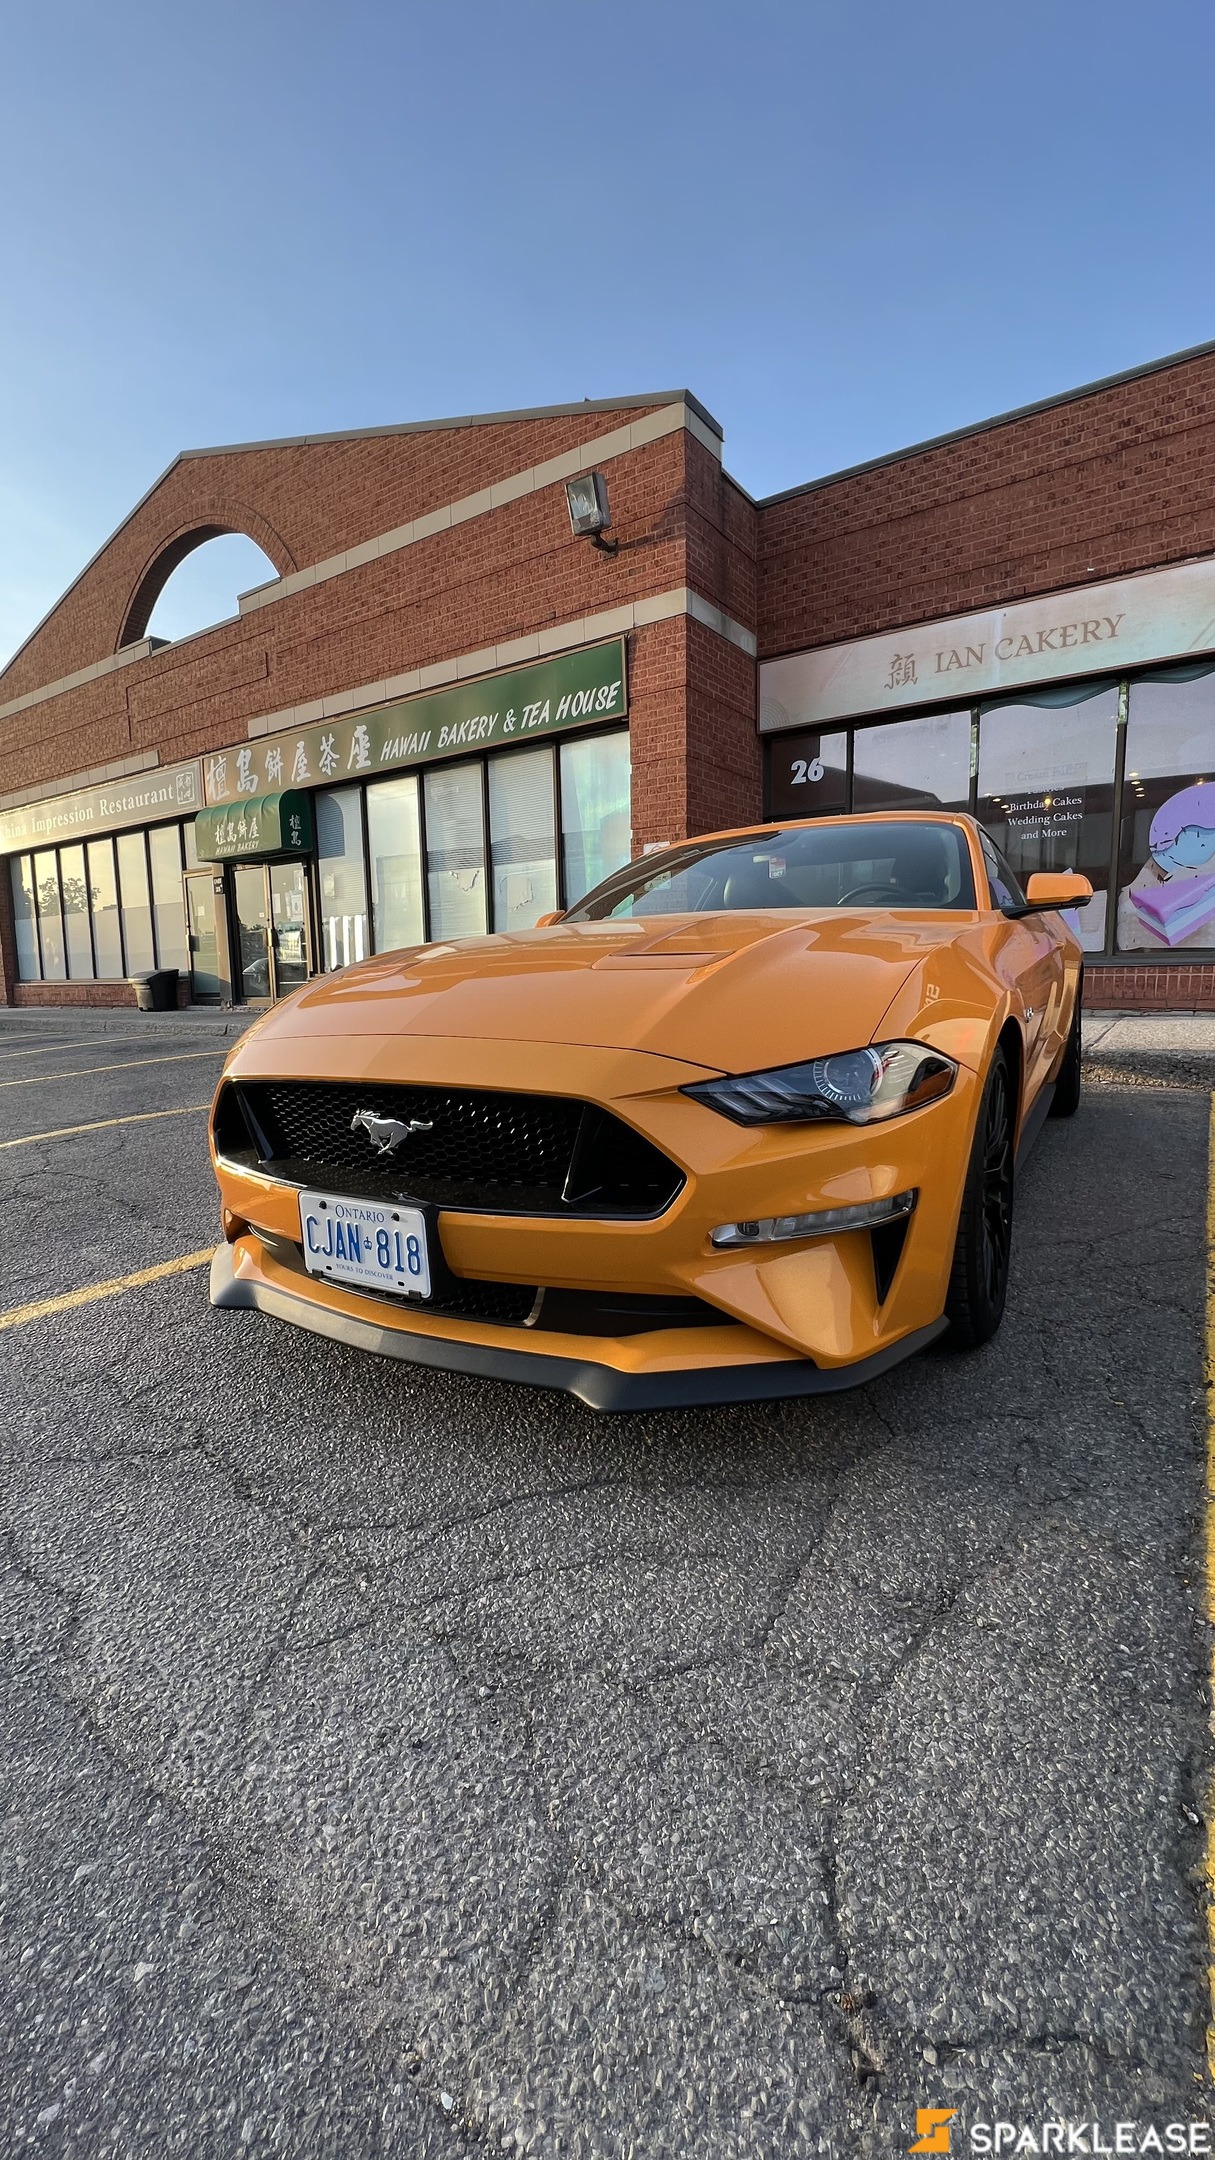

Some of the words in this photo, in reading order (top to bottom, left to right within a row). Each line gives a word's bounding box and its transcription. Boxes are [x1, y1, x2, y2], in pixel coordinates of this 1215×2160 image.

[934, 643, 986, 674] IAN
[994, 613, 1126, 661] CAKERY
[380, 730, 432, 762] HAWAII
[437, 712, 499, 749] BAKERY
[503, 708, 517, 734] &
[520, 699, 551, 729] TEA
[555, 680, 622, 721] HOUSE
[790, 757, 825, 785] 26
[31, 806, 94, 836] Impression
[99, 784, 175, 817] Restaurant
[1052, 796, 1083, 807] Cakes
[1007, 814, 1051, 826] Wedding
[1053, 811, 1083, 822] Cakes
[1021, 830, 1039, 840] and
[1041, 828, 1067, 838] More
[237, 840, 260, 853] BAKERY
[306, 1214, 362, 1264] CJAN
[375, 1227, 421, 1276] 818
[336, 1263, 354, 1272] YOURS
[355, 1266, 364, 1275] TO
[364, 1269, 394, 1281] DISCOVER
